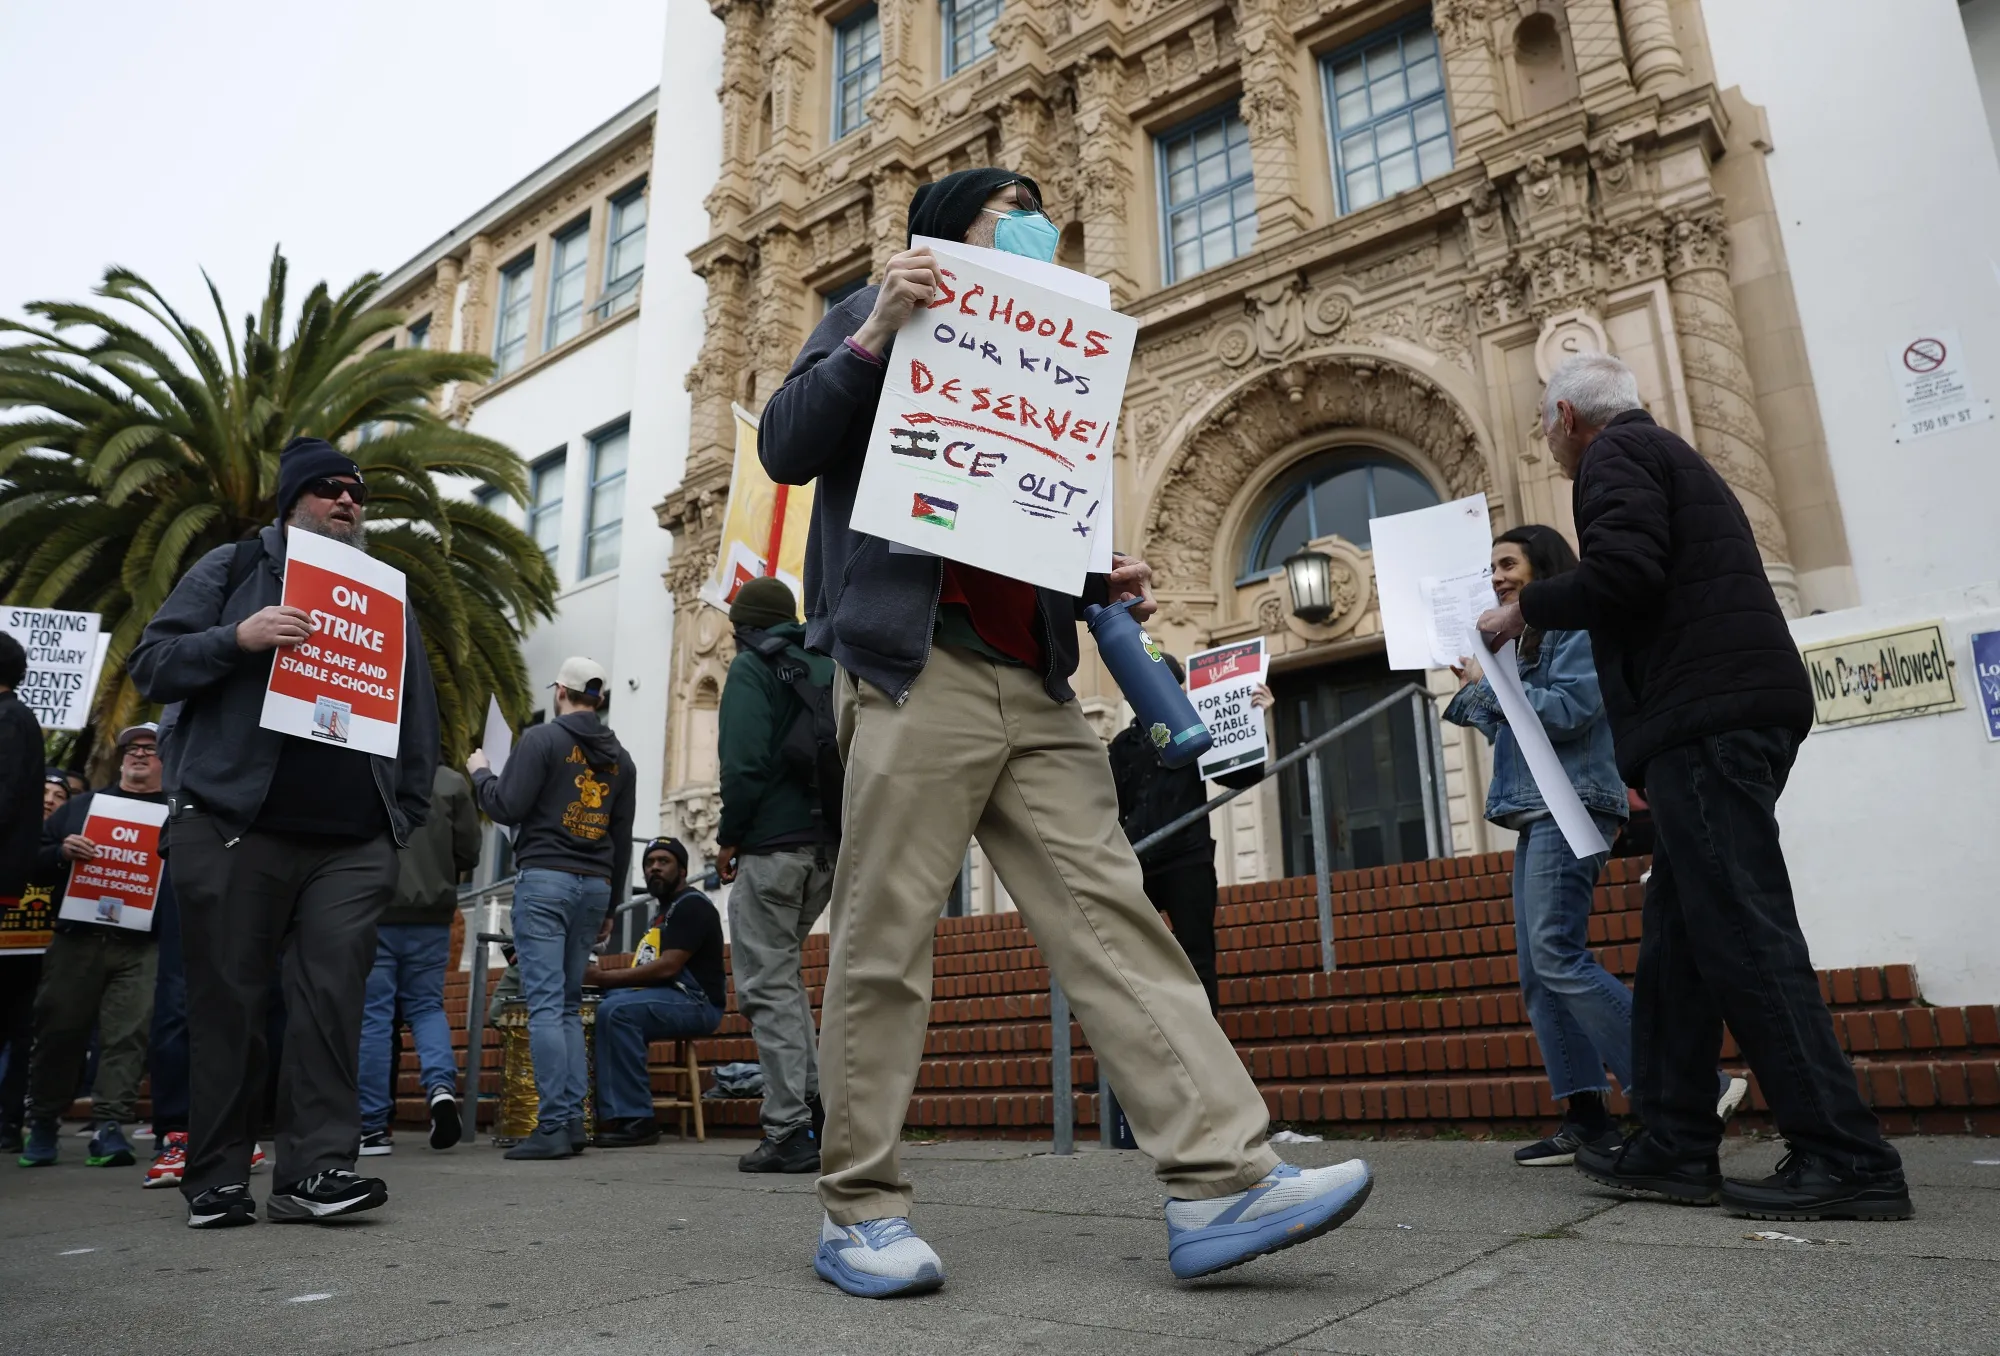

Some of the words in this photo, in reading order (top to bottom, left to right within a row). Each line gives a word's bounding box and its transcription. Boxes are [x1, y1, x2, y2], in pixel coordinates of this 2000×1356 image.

[927, 268, 1113, 358] SCHOOLS
[933, 322, 1002, 366] OUR
[1018, 346, 1091, 395] KIDS
[910, 358, 1110, 462] DESERVE!
[1957, 407, 1972, 422] ST
[331, 585, 368, 615] ON
[10, 611, 87, 632] STRIKING
[310, 608, 385, 653] STRIKE
[29, 629, 62, 647] FOR
[26, 647, 86, 664] CTUARY
[293, 642, 320, 661] FOR
[323, 650, 356, 671] SAFE
[357, 661, 388, 681] AND
[1197, 655, 1215, 667] WE
[22, 671, 82, 690] DENTS
[280, 656, 329, 683] STABLE
[330, 672, 395, 701] SCHOOLS
[1811, 660, 1837, 702] No
[1879, 638, 1945, 691] Allowed
[21, 688, 74, 707] SERVE
[1198, 695, 1221, 712] FOR
[1224, 685, 1252, 704] SAFE
[1214, 703, 1241, 720] AND
[1209, 714, 1249, 736] STABLE
[1212, 725, 1257, 749] CHOOLS
[111, 826, 139, 843] ON
[95, 844, 148, 866] STRIKE
[83, 864, 103, 876] FOR
[105, 867, 128, 880] SAFE
[129, 872, 150, 883] AND
[75, 875, 108, 888] STABLE
[110, 880, 154, 896] SCHOOLS
